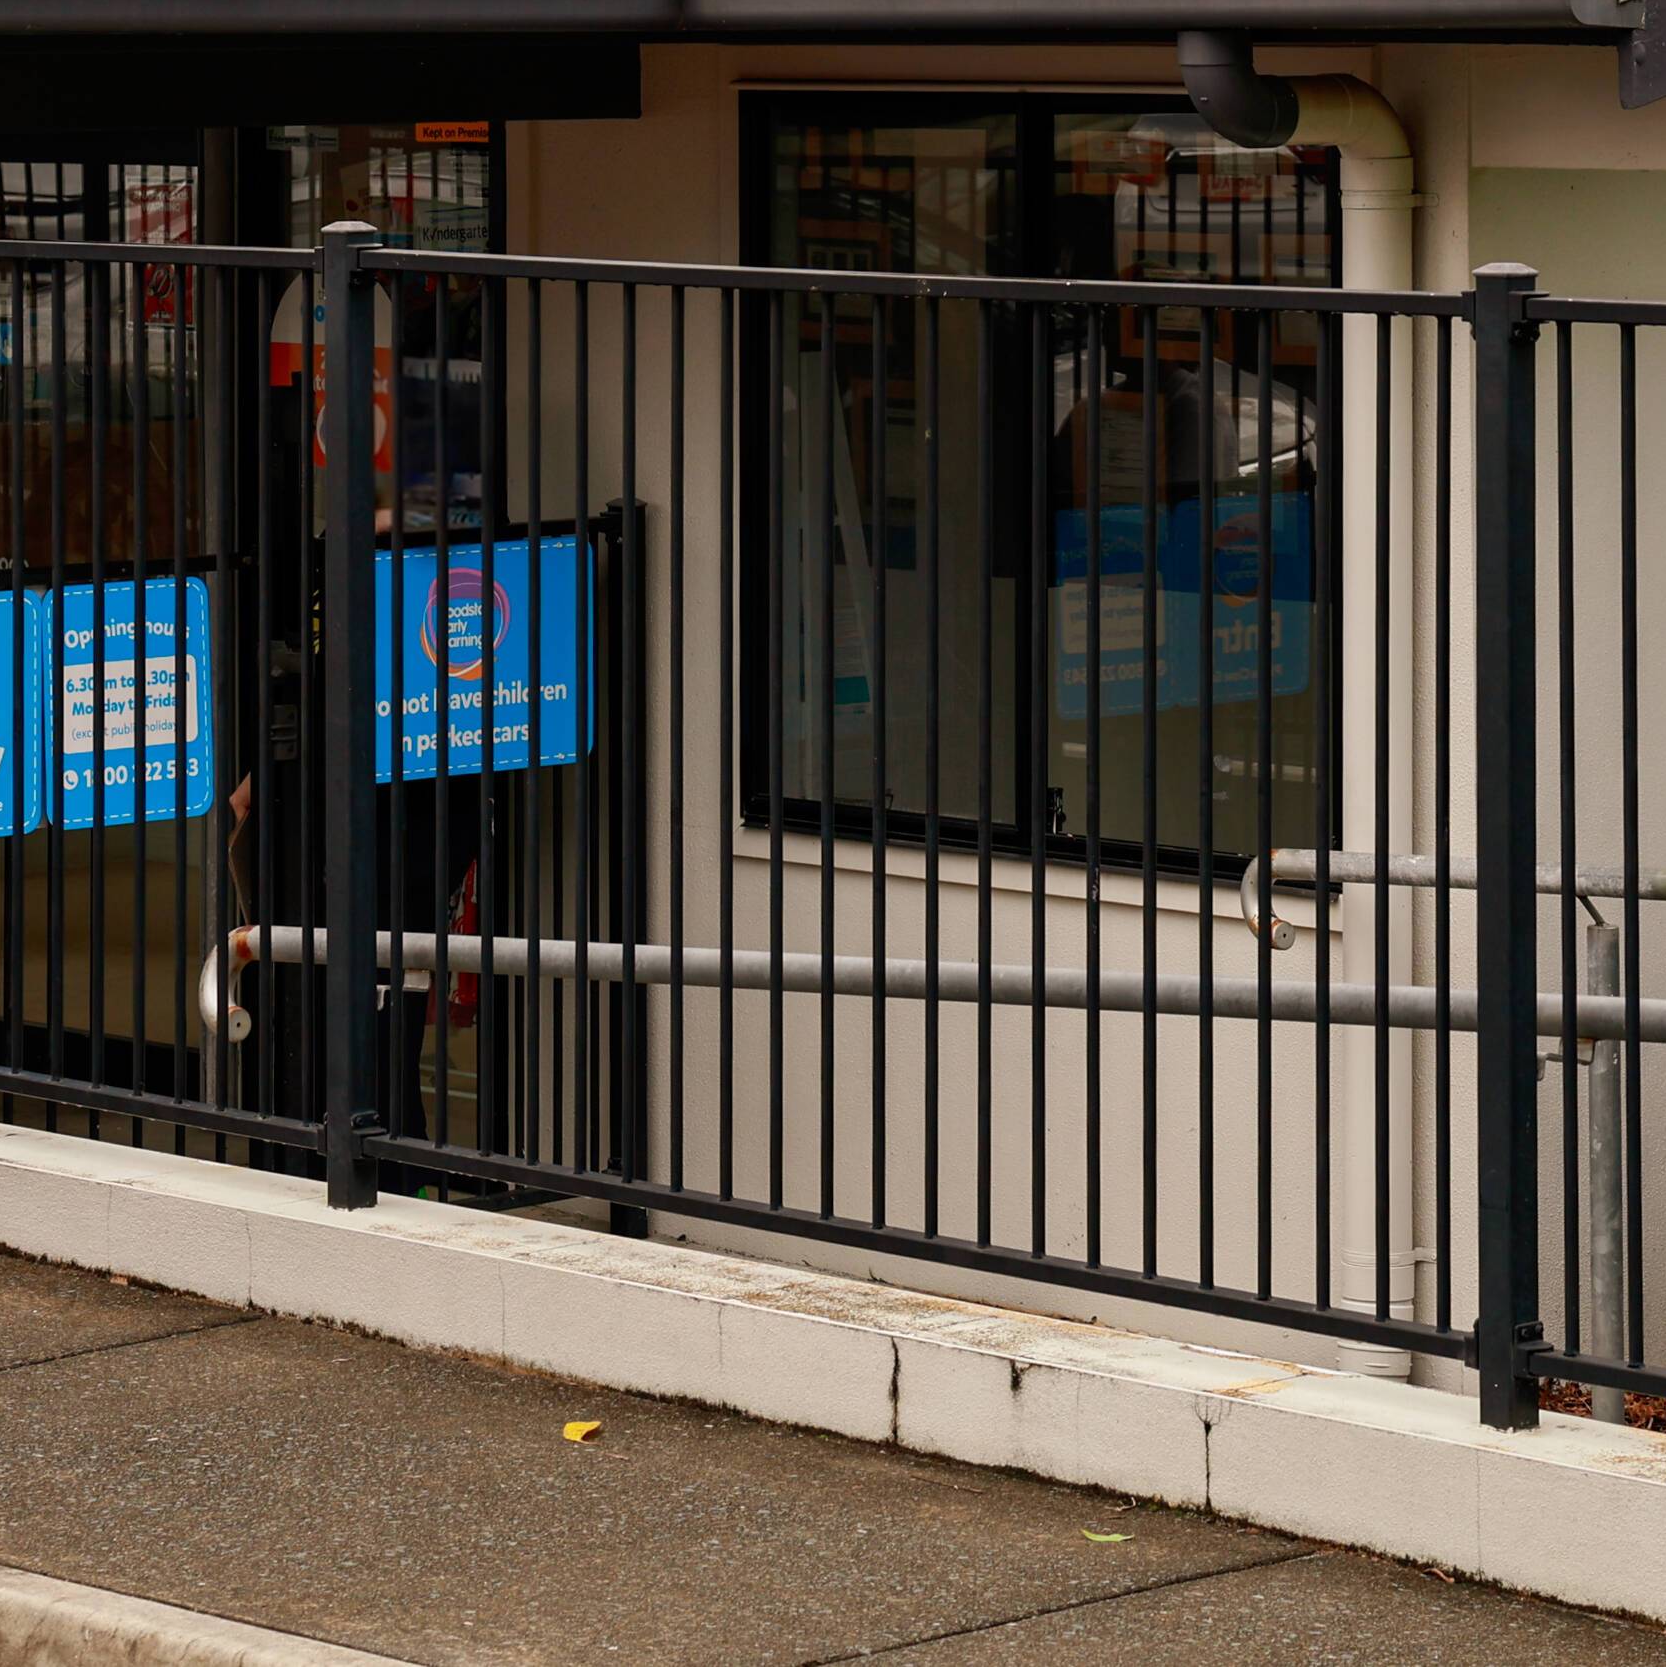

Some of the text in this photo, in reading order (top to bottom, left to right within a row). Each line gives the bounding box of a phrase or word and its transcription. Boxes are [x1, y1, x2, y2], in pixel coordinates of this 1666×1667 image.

[423, 126, 443, 139] Kept
[448, 619, 468, 635] arly
[448, 632, 482, 650] arning
[66, 669, 190, 693] 6.30m to .30p
[72, 698, 126, 716] Moday
[376, 700, 392, 717] o
[433, 688, 482, 712] lave
[493, 723, 529, 744] cars
[83, 757, 199, 788] 100 22 53
